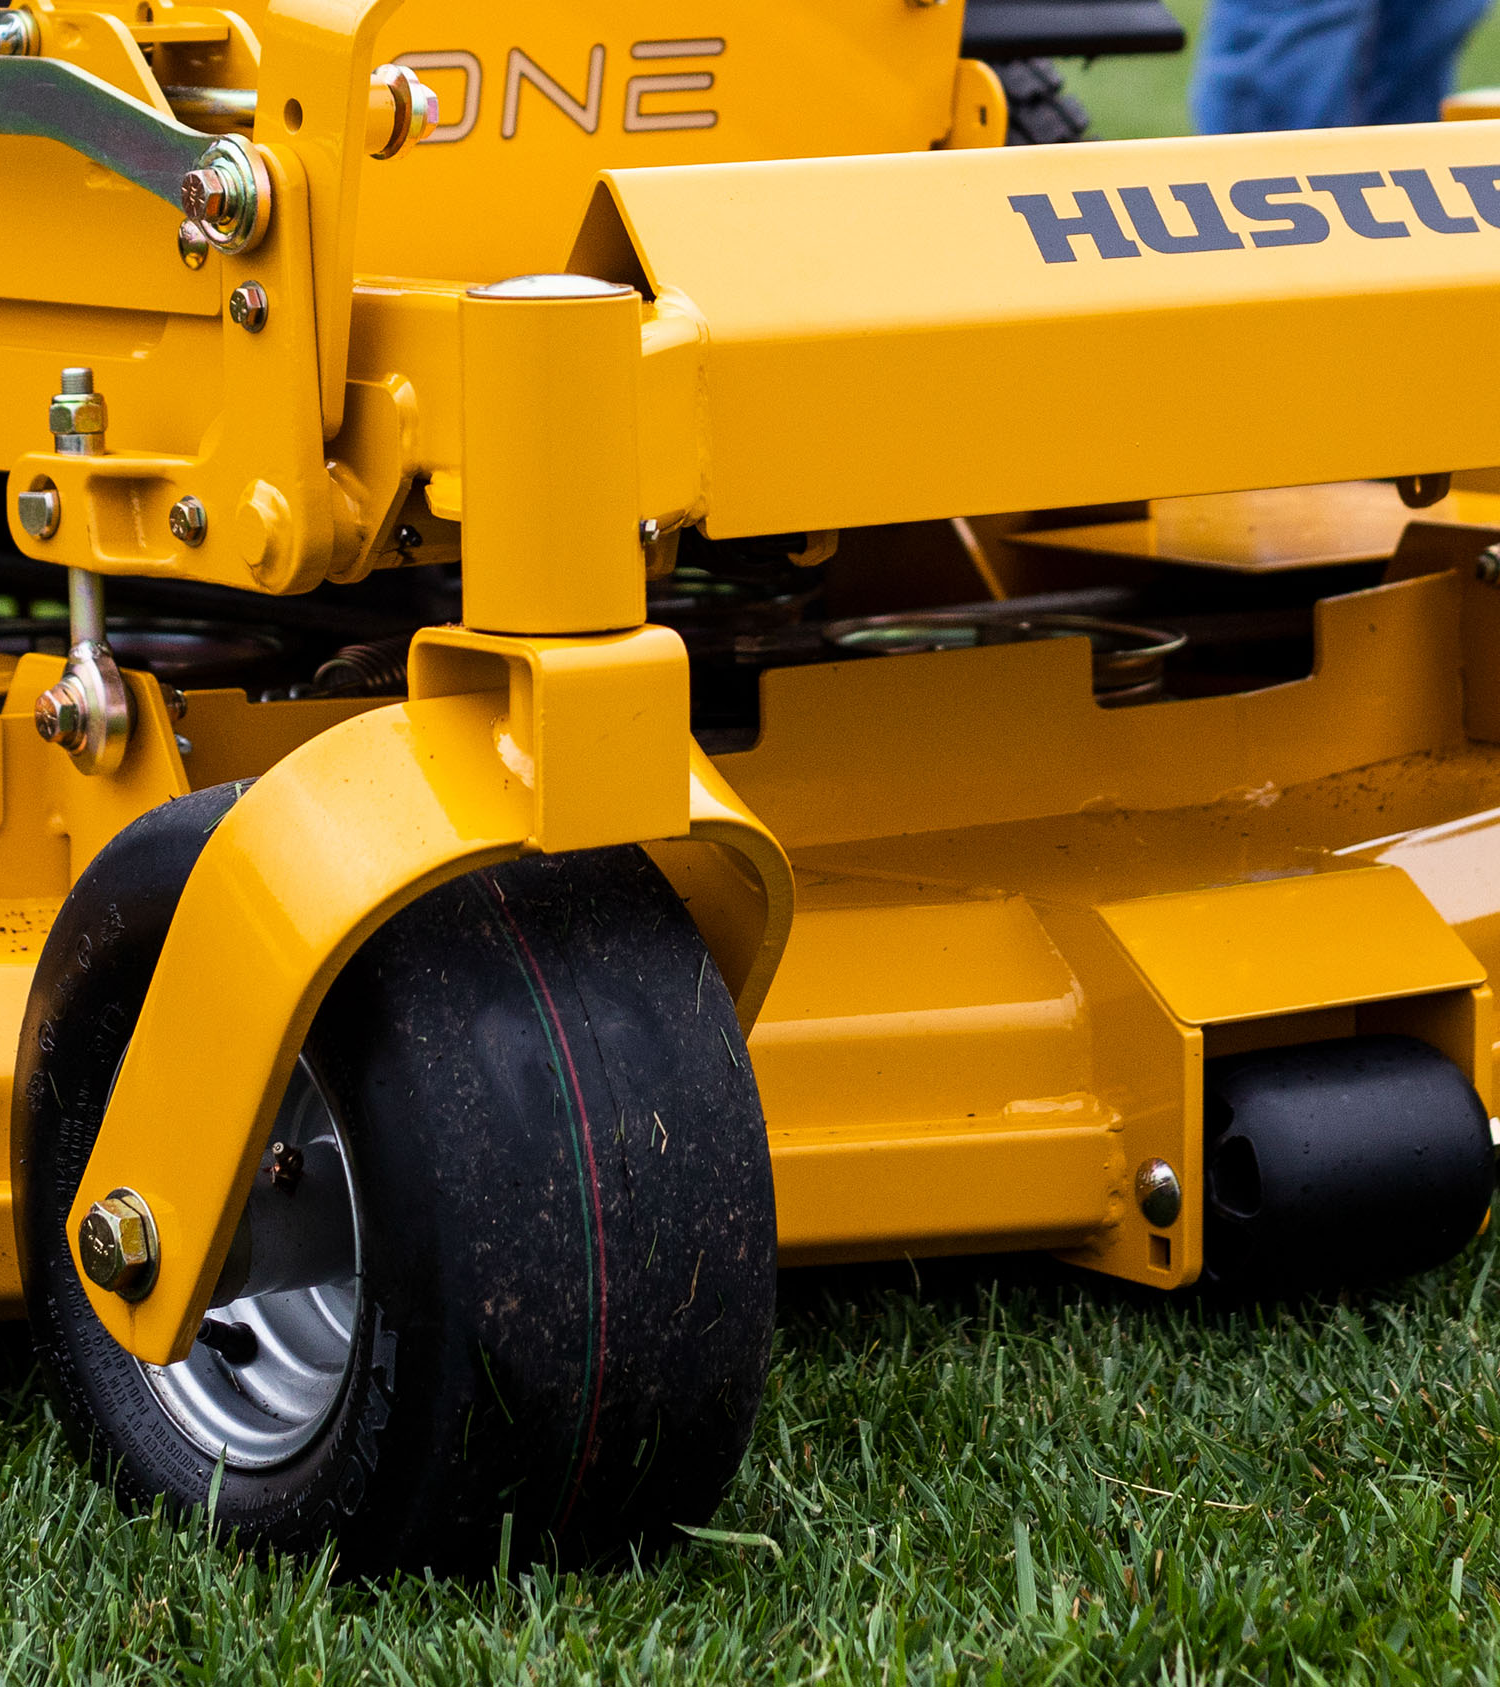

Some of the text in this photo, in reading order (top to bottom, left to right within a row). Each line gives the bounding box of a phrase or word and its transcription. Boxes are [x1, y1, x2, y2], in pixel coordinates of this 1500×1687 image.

[391, 37, 726, 144] ONE
[63, 1277, 82, 1319] ONLY
[74, 1325, 94, 1358] USE
[106, 1374, 129, 1404] RIM
[125, 1409, 143, 1431] BY
